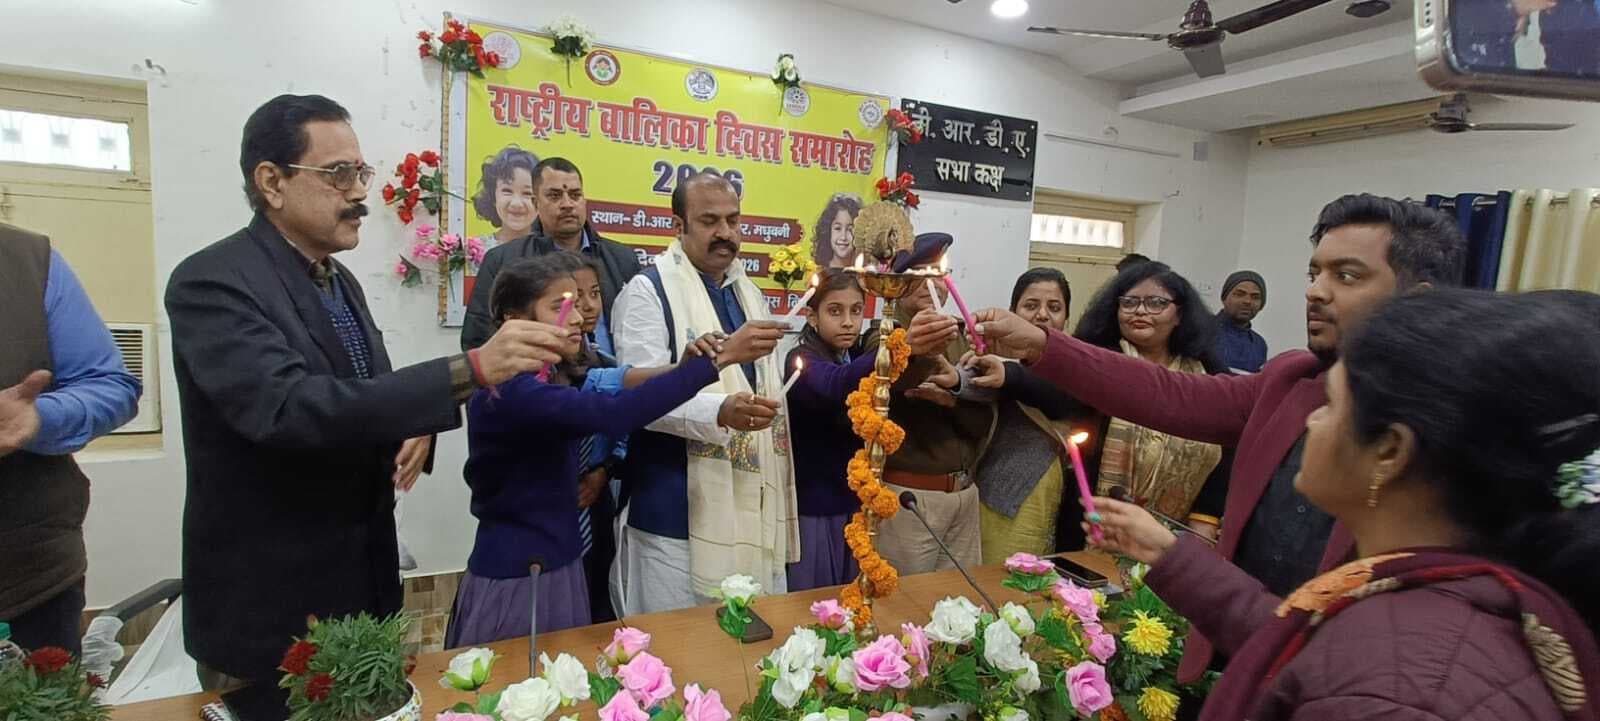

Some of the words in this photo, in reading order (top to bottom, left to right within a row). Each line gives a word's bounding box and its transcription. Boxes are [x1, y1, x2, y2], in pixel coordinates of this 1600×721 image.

[487, 82, 593, 139] राष्ट्रीय
[597, 97, 710, 154] बालिका
[715, 111, 786, 165] दिवस
[789, 129, 876, 175] समारोह
[936, 157, 971, 182] सभा
[974, 162, 1005, 192] कक्ष
[591, 210, 631, 225] स्थान-
